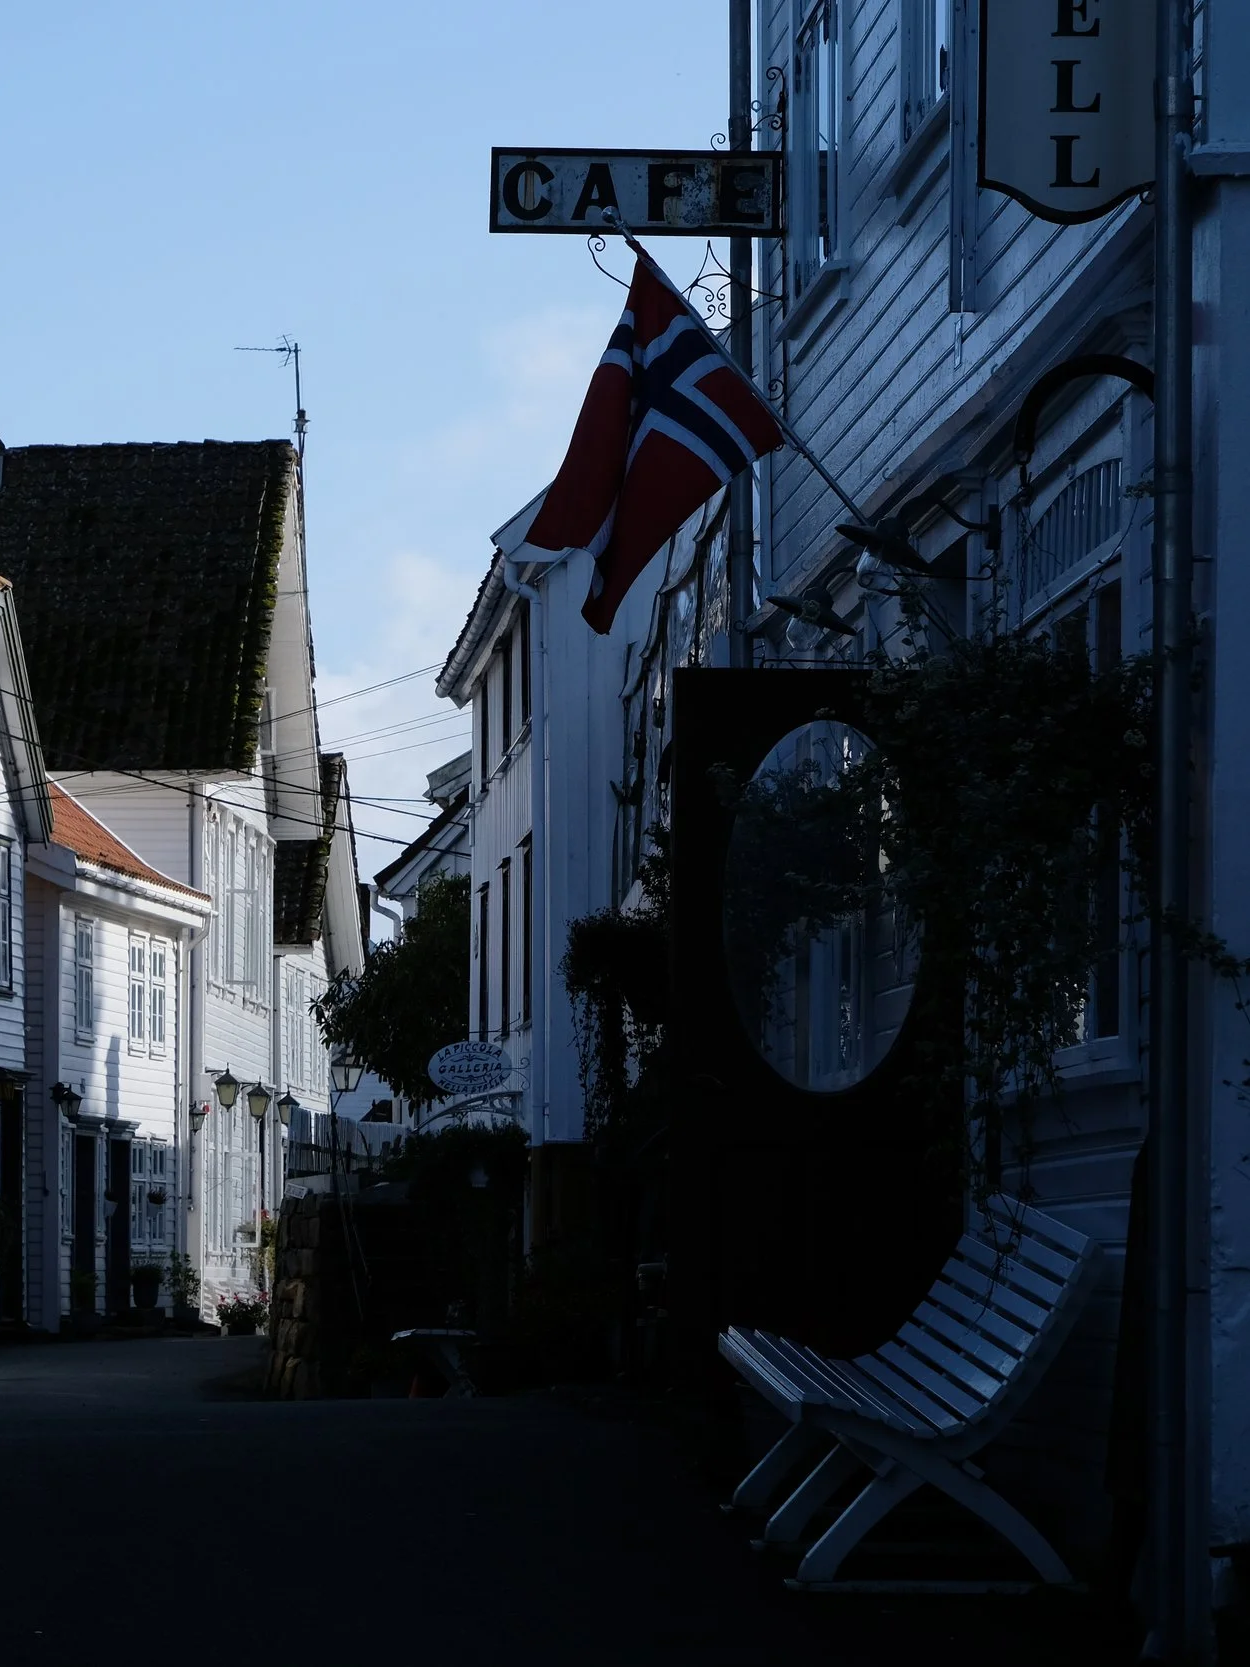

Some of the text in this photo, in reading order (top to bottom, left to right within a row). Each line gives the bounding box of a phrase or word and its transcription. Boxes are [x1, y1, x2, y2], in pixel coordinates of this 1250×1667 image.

[502, 160, 765, 223] CAFE
[437, 1043, 502, 1062] LA PICCOLA
[438, 1062, 502, 1074] GALLERIA
